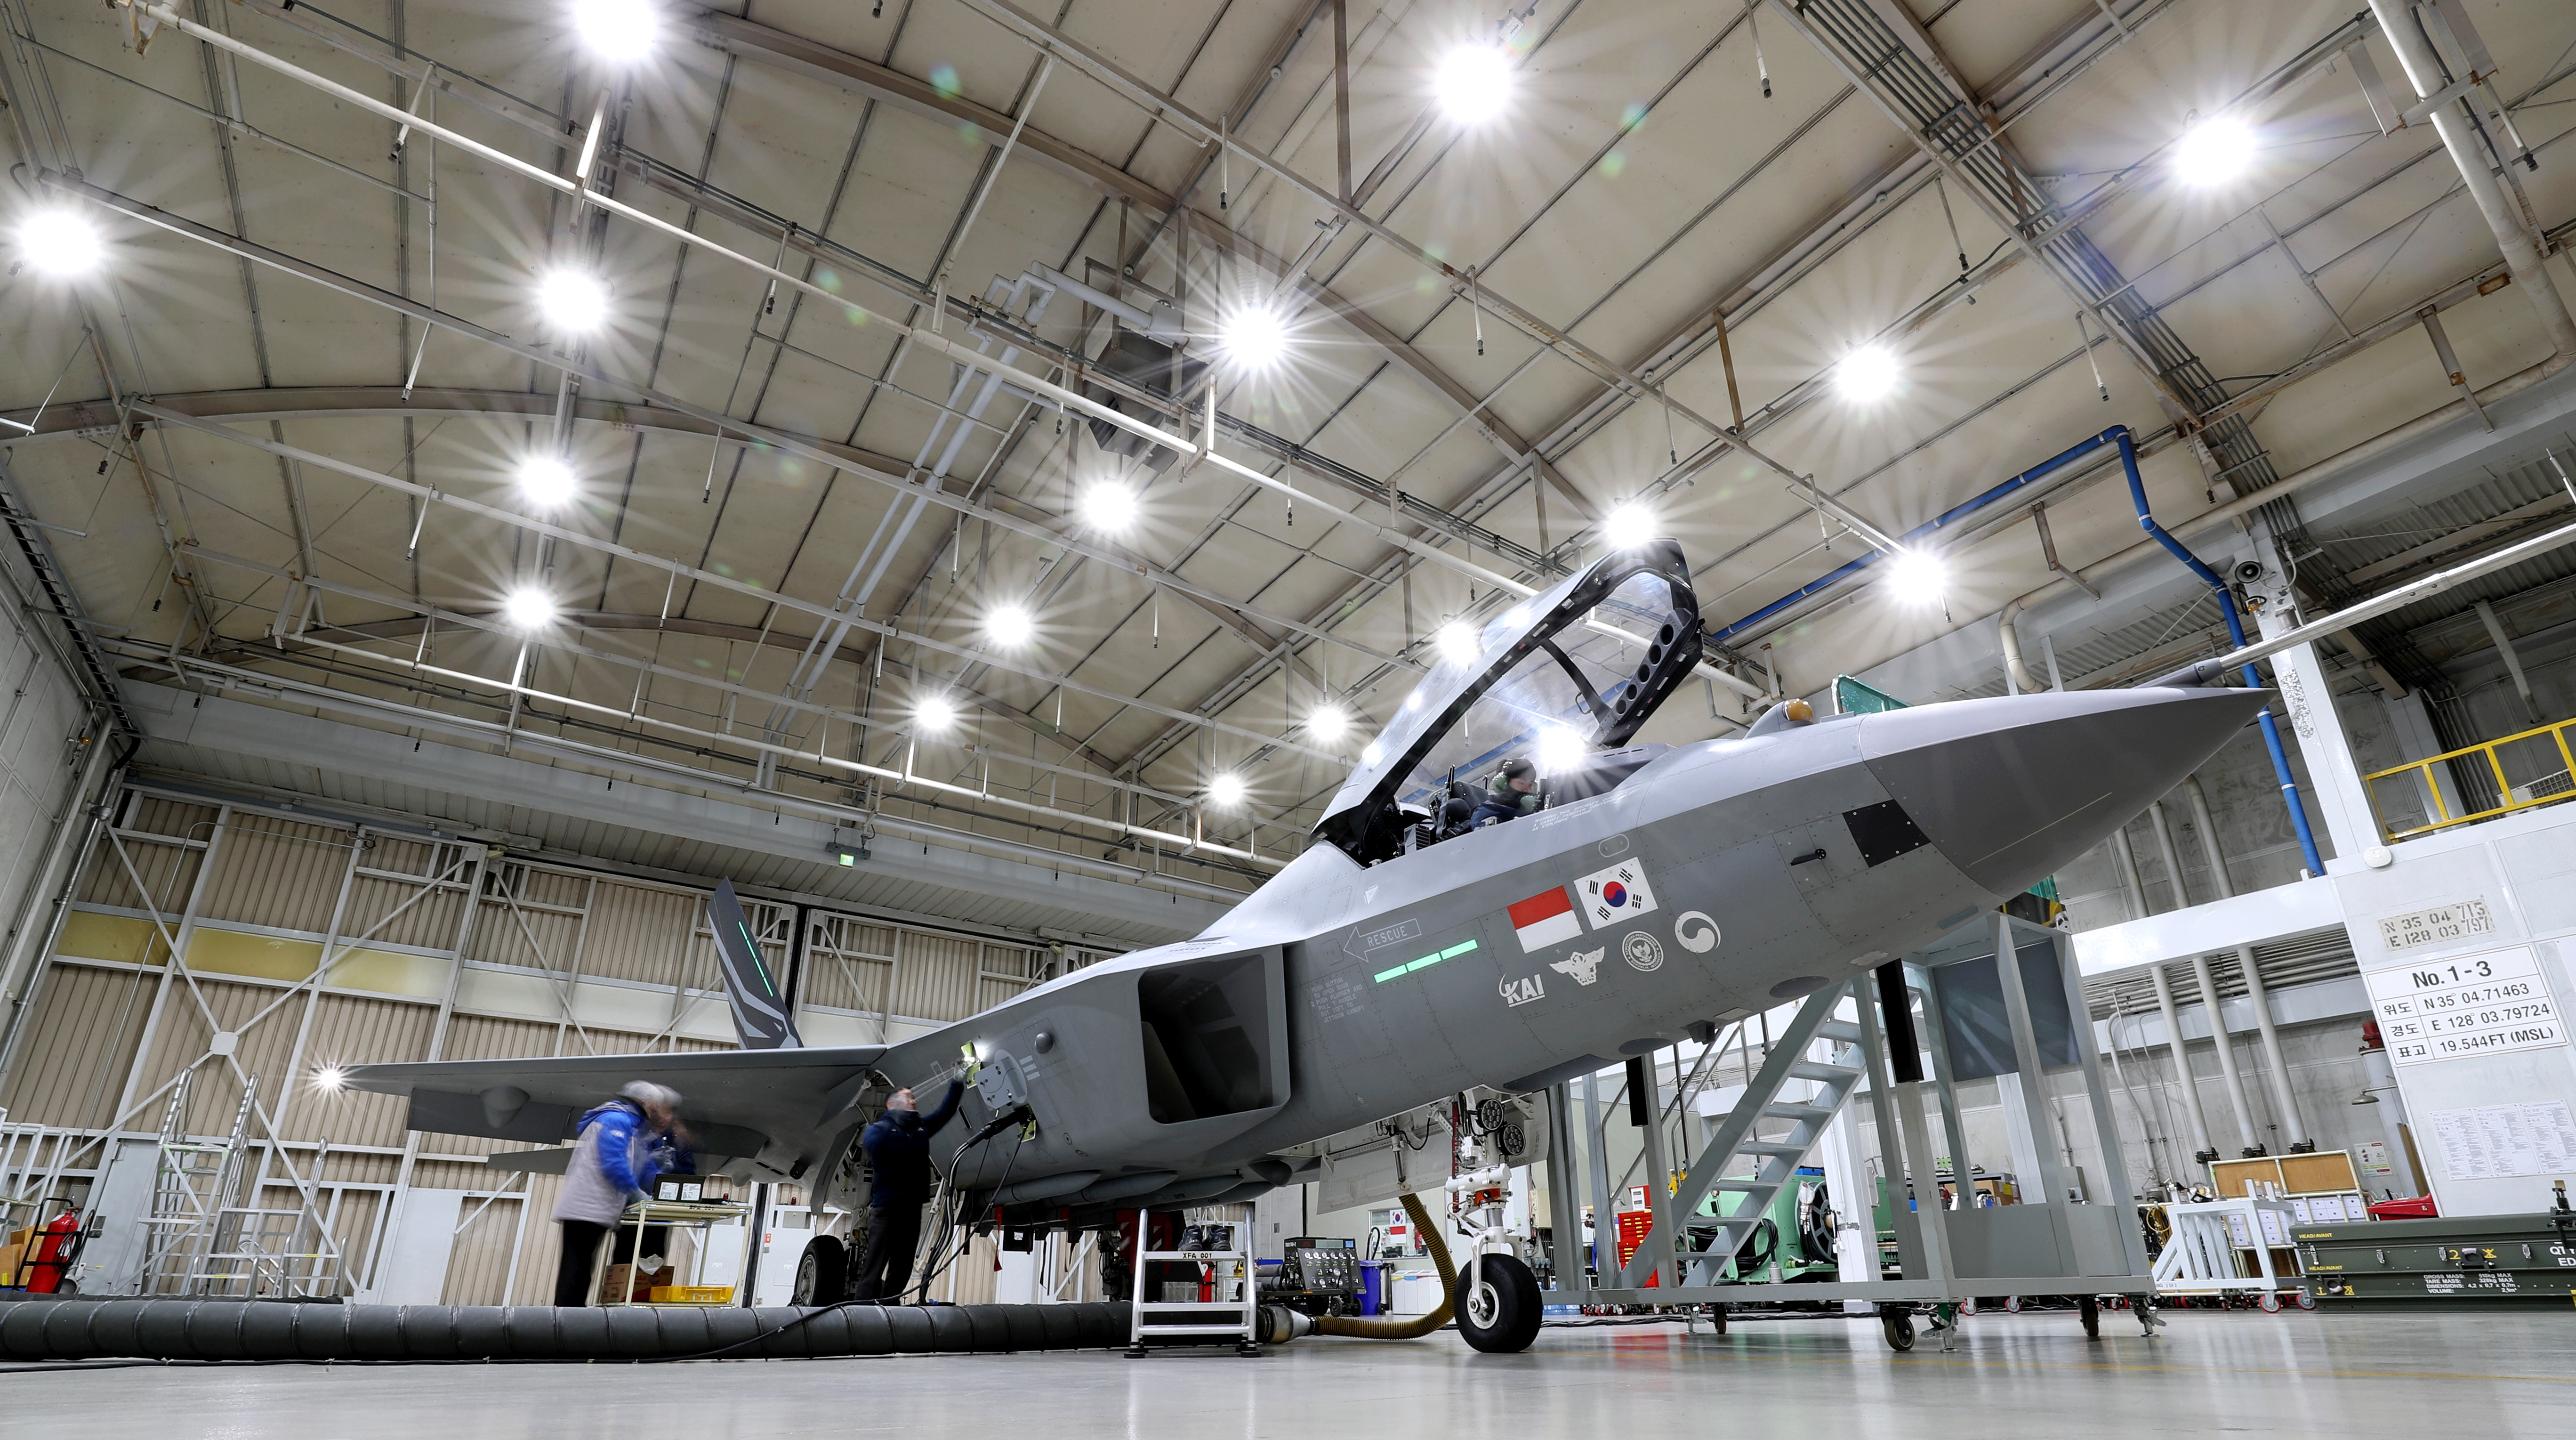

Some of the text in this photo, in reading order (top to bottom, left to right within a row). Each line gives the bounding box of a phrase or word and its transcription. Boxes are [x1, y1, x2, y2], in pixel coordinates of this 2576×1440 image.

[2384, 902, 2485, 933] N 35 04 715
[1367, 925, 1408, 947] RESCUE
[2390, 916, 2490, 947] E 128 03 797
[1311, 985, 1323, 993] PUSH
[1325, 978, 1343, 987] BUTTON
[1322, 987, 1335, 995] OPEN
[1336, 982, 1349, 990] DOOR
[1499, 973, 1545, 1006] KAI
[1316, 997, 1328, 1005] PUSH
[1330, 989, 1351, 1000] PLUNGER
[1338, 994, 1357, 1004] HANDLE
[2423, 998, 2435, 1010] N
[2461, 983, 2530, 1004] 04.71463
[1324, 1005, 1364, 1023] JETTISON CANOPY
[2383, 1002, 2412, 1016] 위도
[2431, 1020, 2441, 1031] E
[2480, 1003, 2550, 1024] 03.79724
[2390, 1023, 2419, 1037] 경도
[2439, 1027, 2554, 1052] 19.544FT (MSL)
[2398, 1044, 2427, 1058] 표고
